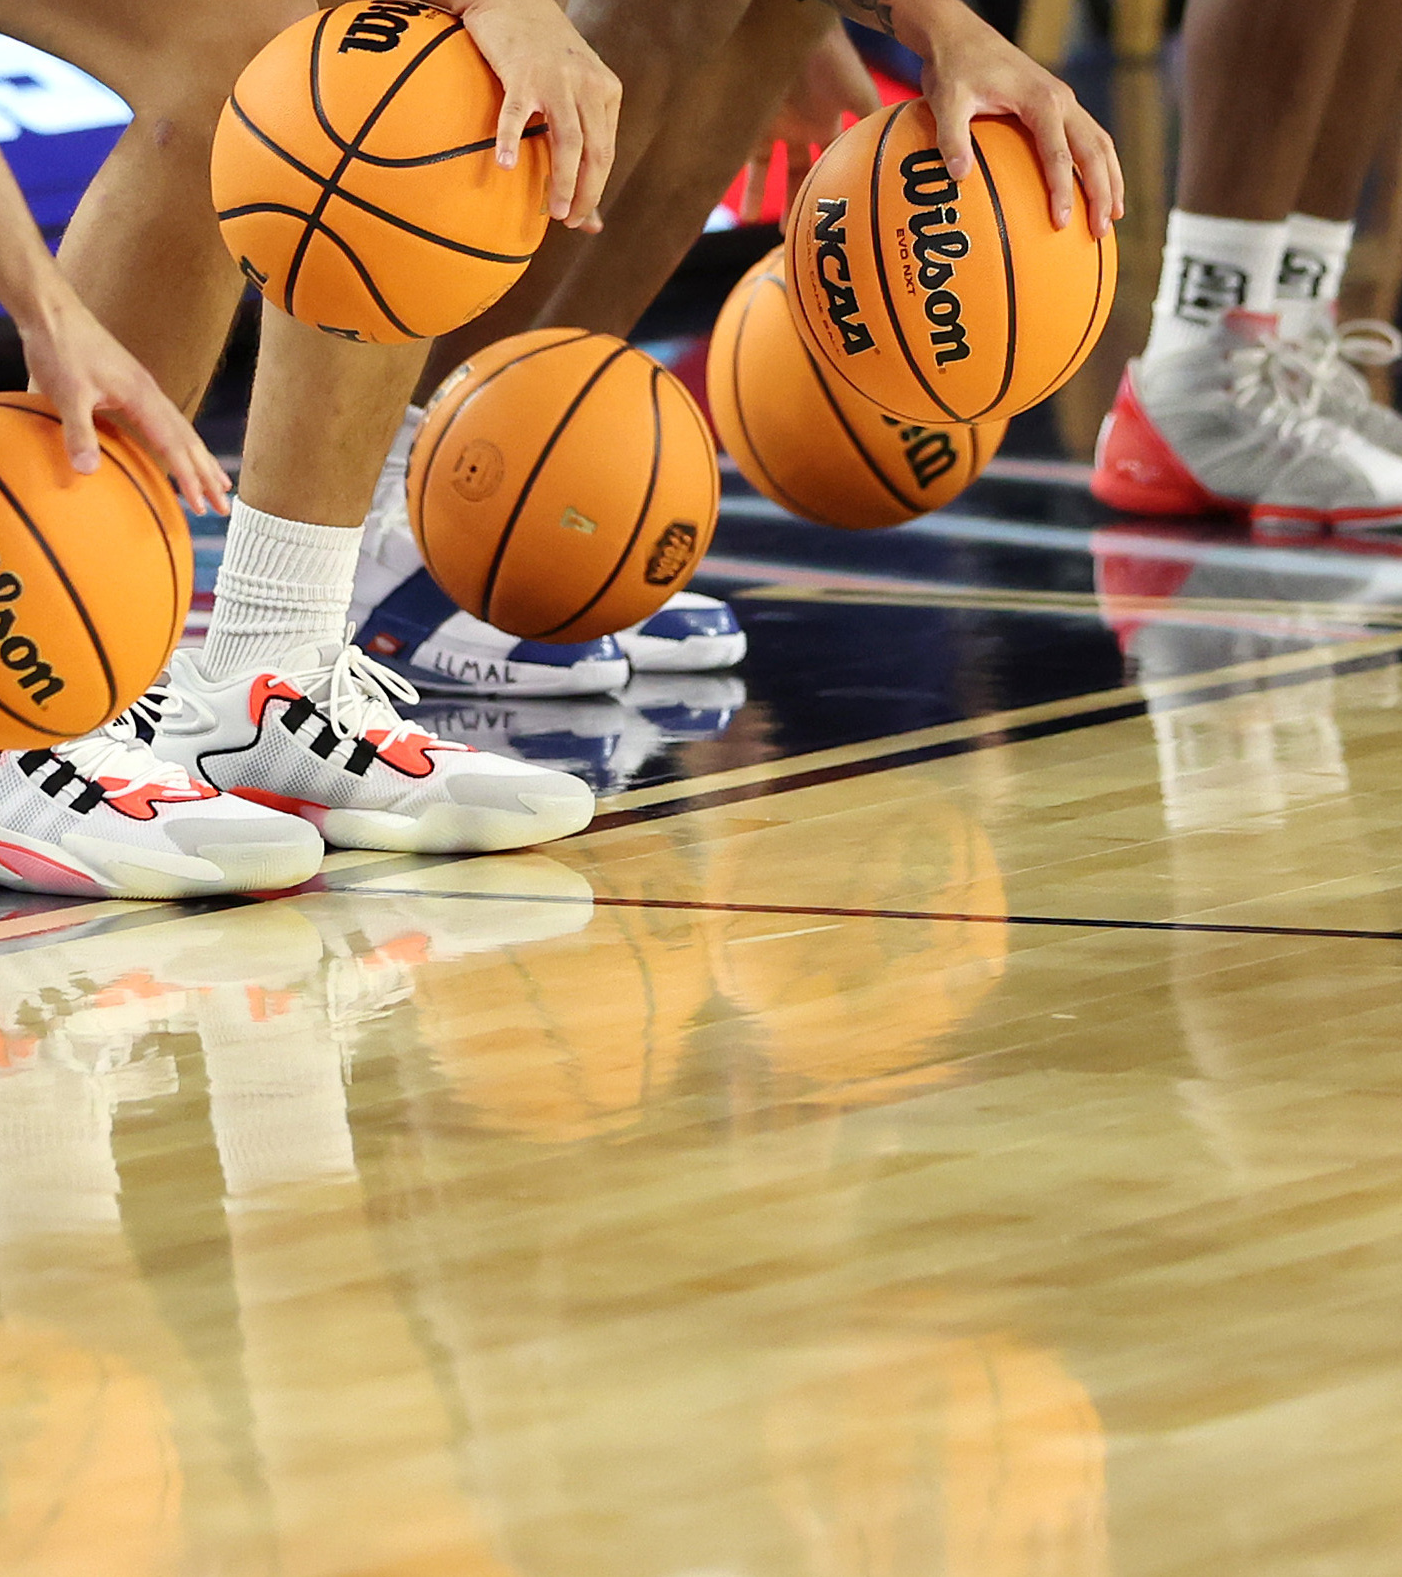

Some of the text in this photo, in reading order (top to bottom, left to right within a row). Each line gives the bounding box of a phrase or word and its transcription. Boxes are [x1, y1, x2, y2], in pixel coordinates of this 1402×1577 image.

[814, 197, 876, 357] NCAA
[896, 228, 916, 296] EVO NXT
[899, 147, 972, 369] Wilson
